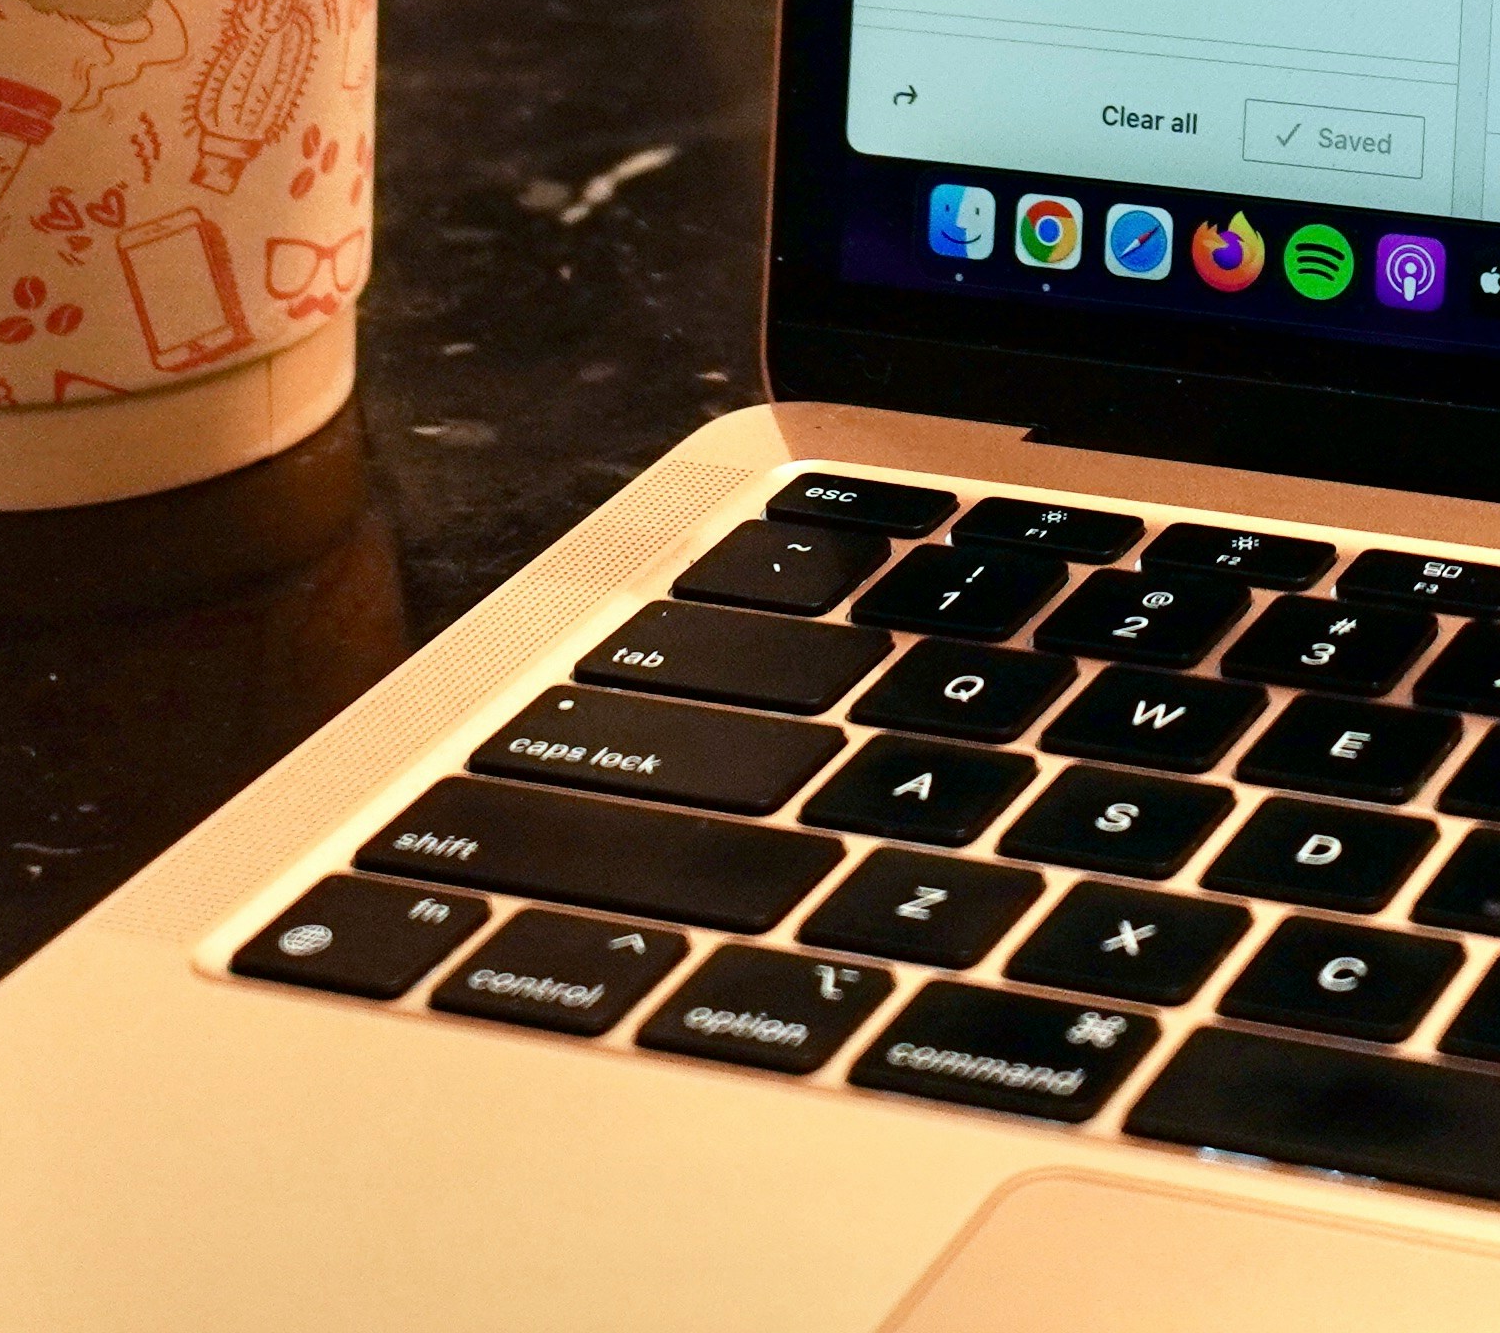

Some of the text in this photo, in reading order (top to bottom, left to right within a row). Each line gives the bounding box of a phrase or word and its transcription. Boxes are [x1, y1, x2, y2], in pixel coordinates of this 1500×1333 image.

[1101, 105, 1198, 135] Clear all
[1317, 127, 1392, 155] Saved
[803, 485, 860, 505] esc
[610, 645, 667, 670] tab
[941, 673, 987, 705] Q
[1130, 698, 1188, 731] W
[507, 735, 664, 777] caps lock
[1328, 728, 1373, 761] E
[392, 829, 481, 863] shift
[407, 895, 452, 925] fn
[466, 967, 607, 1011] control
[681, 1004, 810, 1048] option
[886, 1040, 1084, 1096] command
